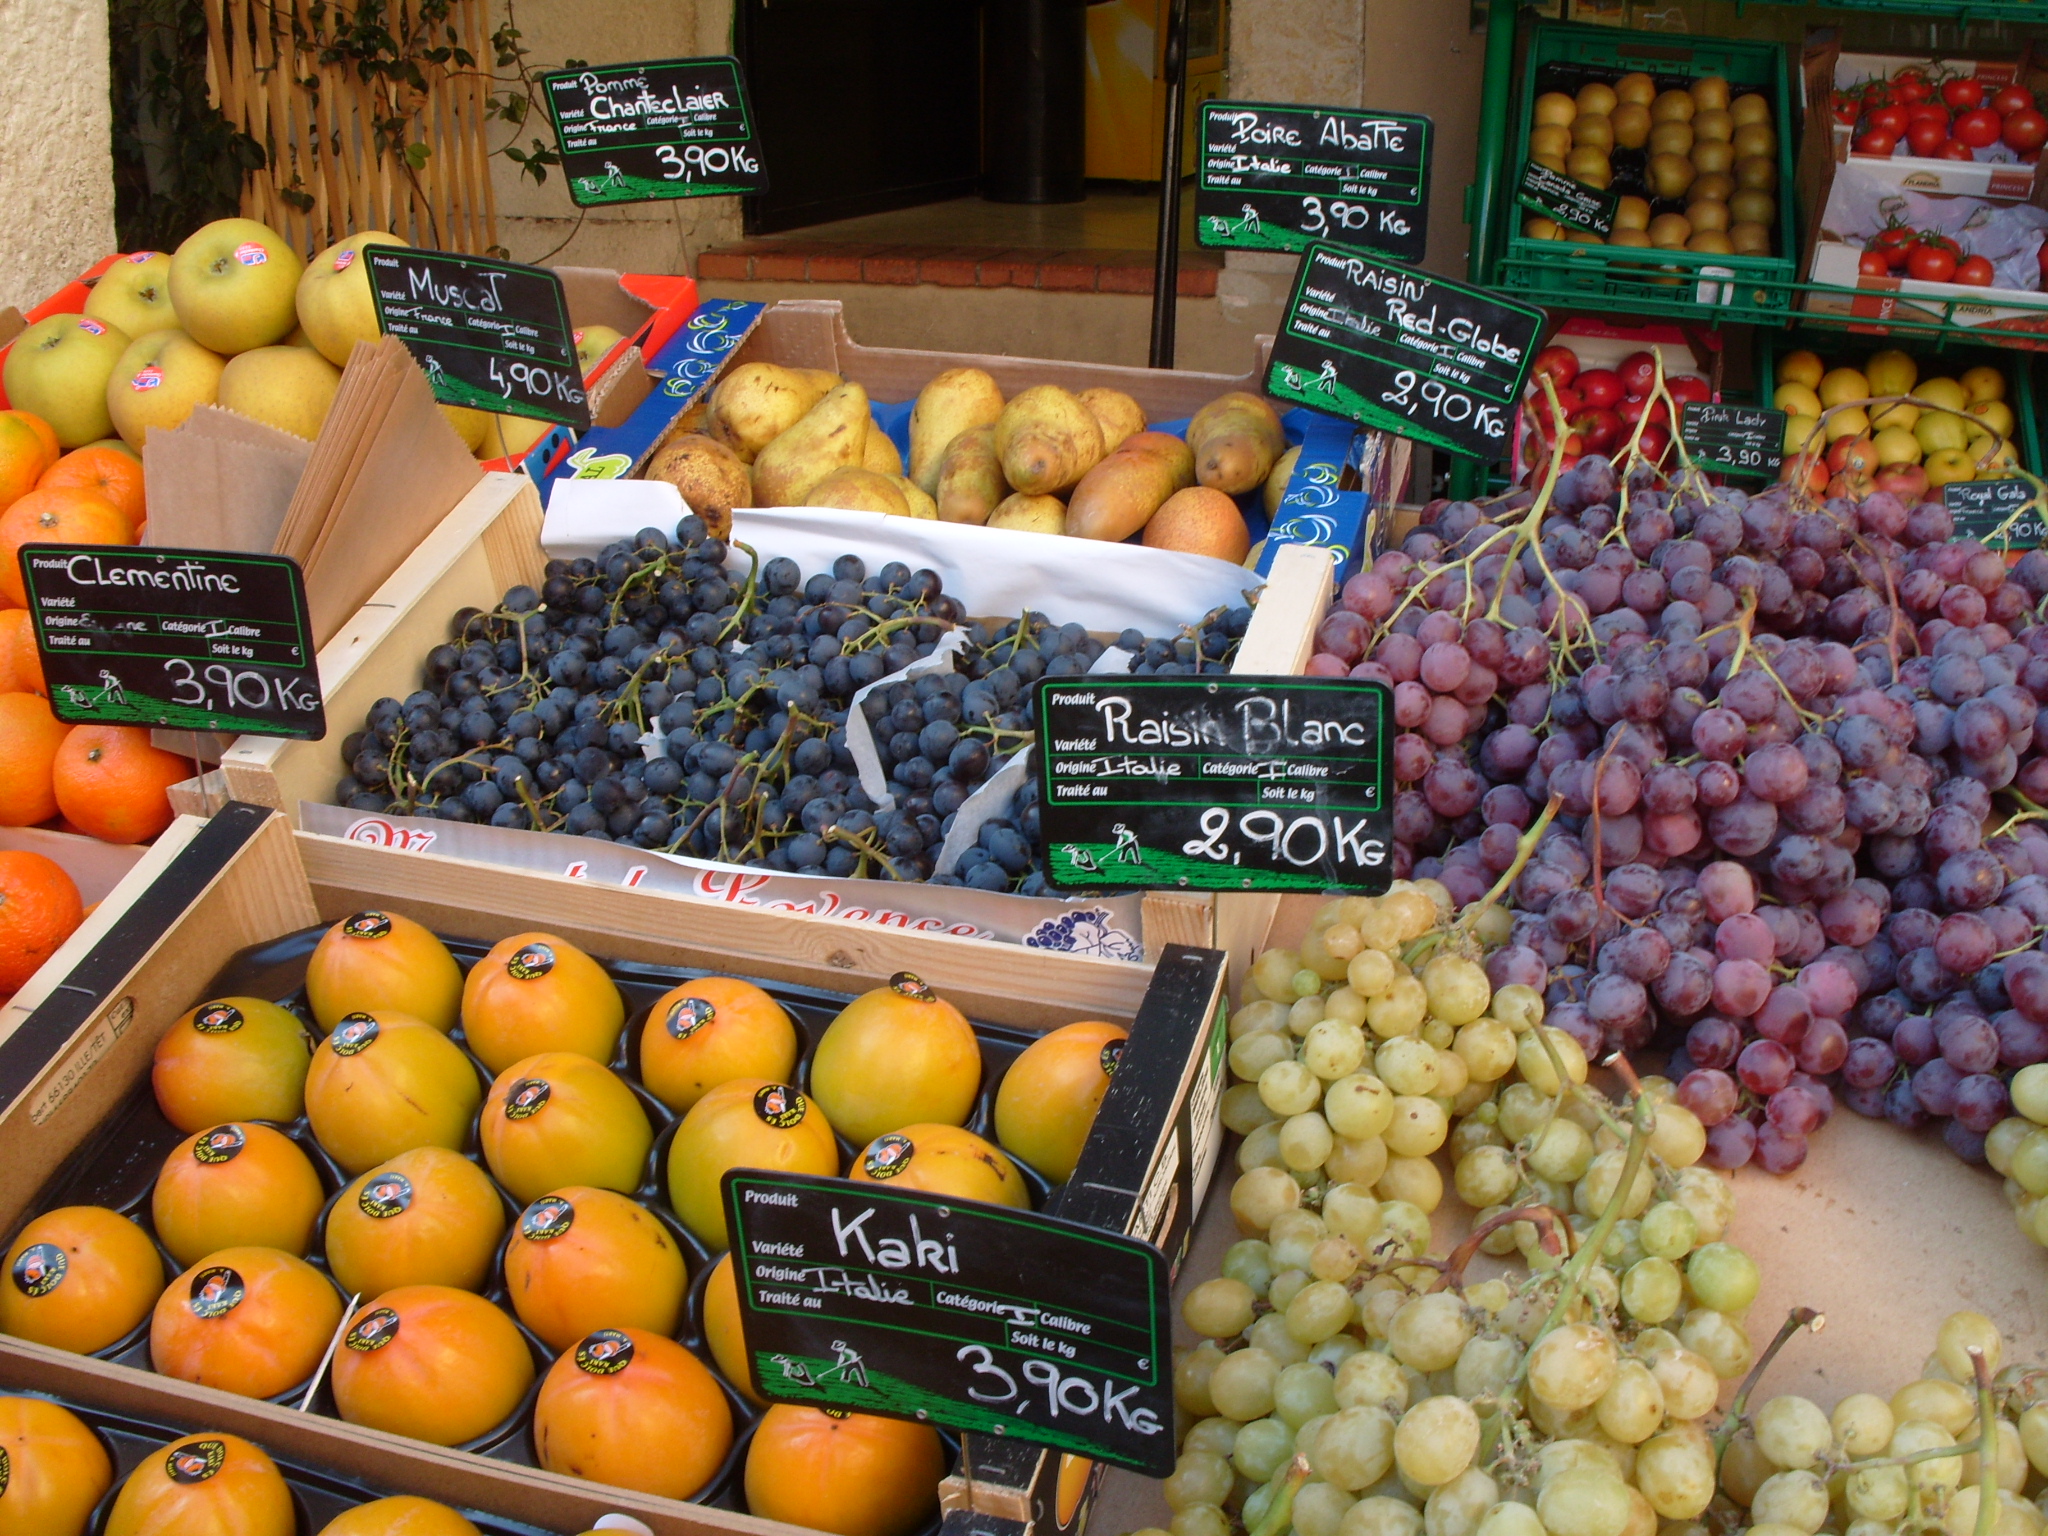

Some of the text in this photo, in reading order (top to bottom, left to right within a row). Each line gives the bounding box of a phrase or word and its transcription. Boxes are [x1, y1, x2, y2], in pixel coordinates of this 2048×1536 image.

[552, 80, 578, 91] Produit
[560, 109, 584, 119] Variété
[564, 123, 587, 134] Origine
[586, 120, 637, 133] France
[647, 114, 678, 126] Catégorie
[694, 113, 717, 123] Calibre
[739, 124, 745, 132] €
[567, 128, 714, 149] Traité au Soit le kg
[1208, 144, 1237, 154] Variété
[1208, 159, 1235, 170] Origine
[1231, 155, 1292, 174] Italie
[1305, 165, 1342, 176] Catégorie
[1360, 169, 1388, 180] Calibre
[1207, 175, 1378, 197] Traité au Soit le kg
[1410, 187, 1418, 196] €
[1991, 183, 2025, 192] PRINCESS
[1301, 195, 1369, 238] 3,90
[374, 256, 400, 268] Produit
[1315, 252, 1347, 270] Produit
[381, 290, 406, 301] Variété
[1305, 286, 1336, 302] Variété
[384, 306, 409, 317] Origine
[406, 306, 453, 327] France
[468, 317, 500, 330] Catégorie
[515, 325, 539, 337] Calibre
[388, 323, 535, 355] Traité au Soit le kg
[1299, 303, 1330, 319] Origine
[1400, 333, 1439, 354] Catégorie
[1456, 352, 1487, 369] Calibre
[560, 348, 567, 357] €
[1294, 320, 1471, 384] Traité au Soit le kg
[1504, 383, 1512, 393] €
[1735, 411, 1766, 426] Lady
[1716, 445, 1761, 466] 3,90
[1997, 485, 2026, 500] Gala
[33, 558, 69, 569] Produit
[41, 597, 76, 608] Variété
[45, 615, 79, 627] Origine
[162, 621, 206, 634] Catégorie
[229, 624, 261, 637] Calibre
[48, 636, 254, 658] Traité au Soit le kg
[291, 646, 299, 656] €
[1051, 693, 1096, 706] Produit
[1234, 695, 1366, 757] Blanc
[1054, 739, 1097, 752] Variété
[1055, 762, 1097, 775] Origine
[1095, 755, 1182, 777] Italie
[1202, 763, 1259, 776] Catégorie
[1287, 764, 1329, 777] Calibre
[1056, 784, 1315, 802] Traité au Soit le kg
[1365, 787, 1376, 798] €
[744, 1190, 960, 1275] Produit Kaki
[752, 1240, 805, 1258] Variété
[755, 1266, 806, 1282] Origine
[804, 1266, 914, 1306] Italie
[936, 1290, 1006, 1316] Catégorie
[1040, 1311, 1092, 1336] Calibre
[758, 1289, 1077, 1359] Traité au Soit le kg
[1136, 1358, 1150, 1370] €
